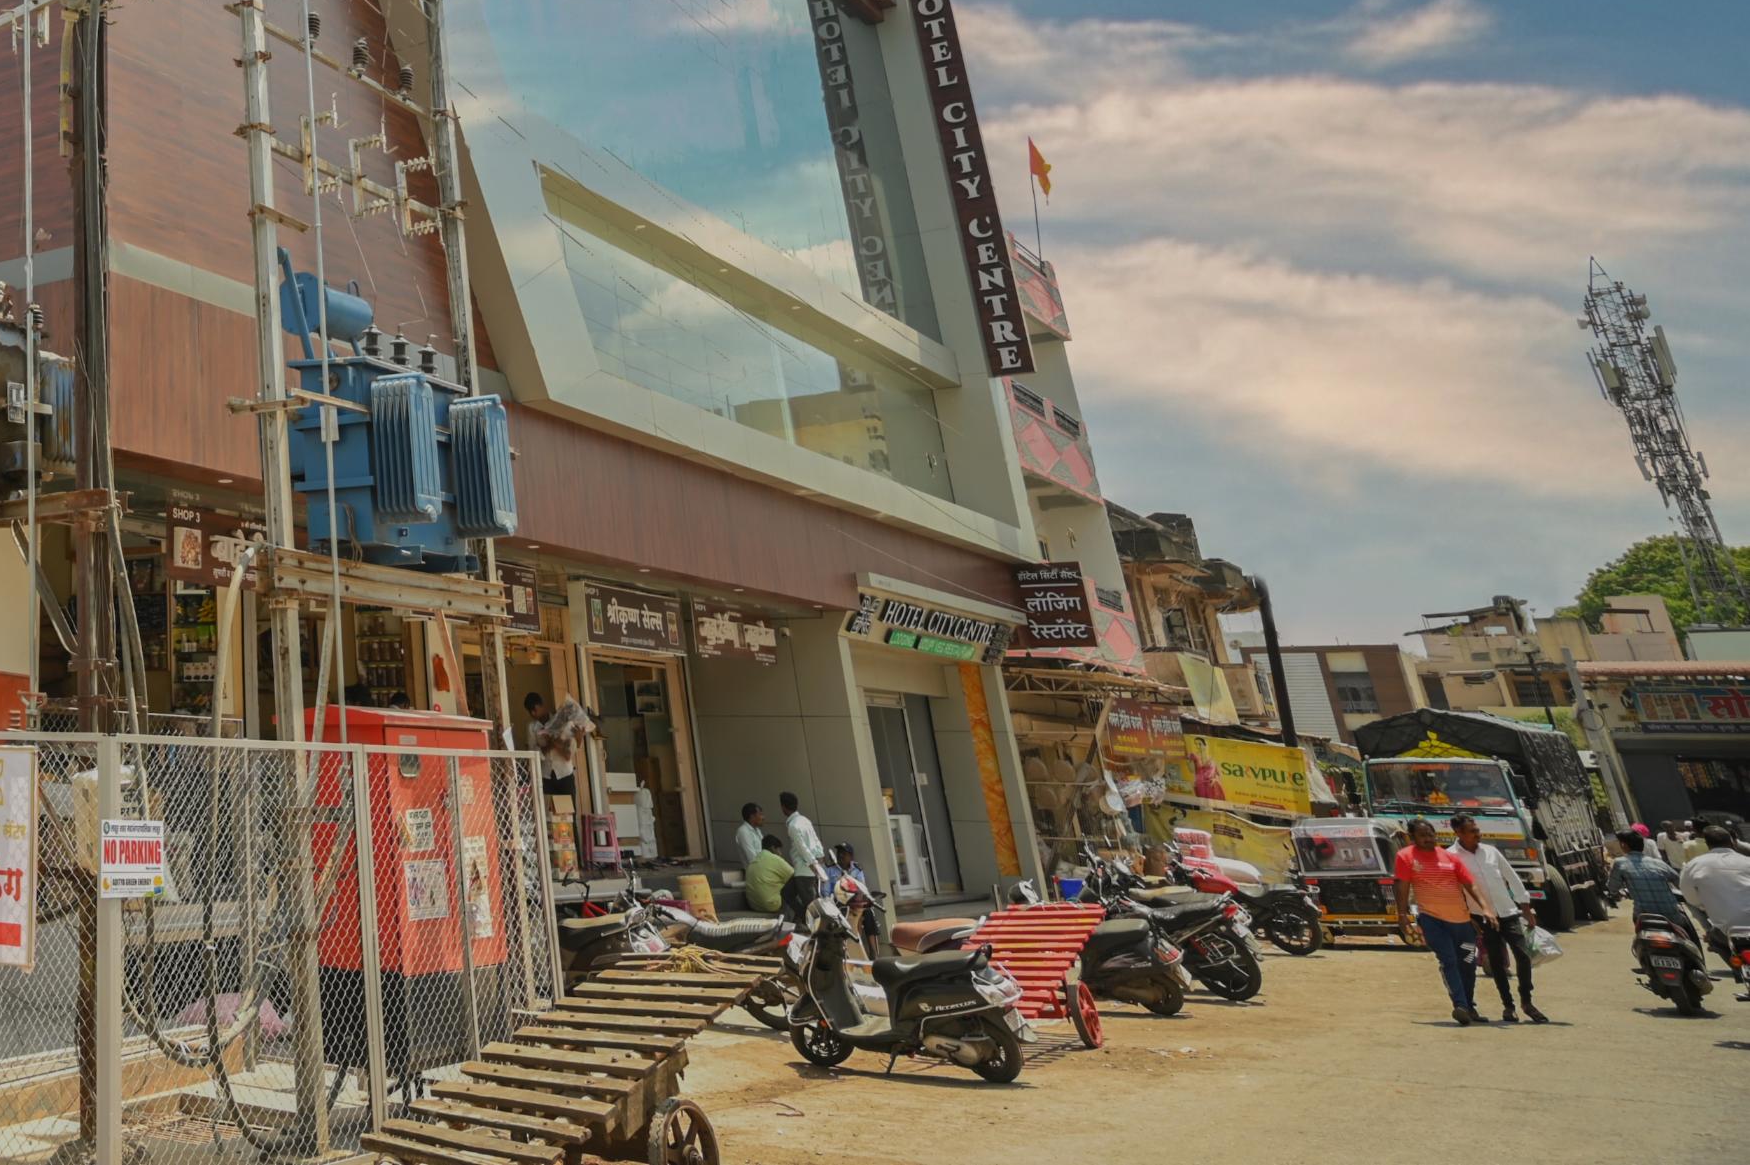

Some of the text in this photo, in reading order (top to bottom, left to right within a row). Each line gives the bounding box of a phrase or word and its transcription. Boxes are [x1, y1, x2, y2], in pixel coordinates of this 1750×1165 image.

[942, 102, 982, 200] CITY
[968, 217, 1023, 372] CENTRE
[172, 507, 201, 524] SHOP 3
[1025, 591, 1082, 612] लॉजिंग
[607, 597, 641, 635] श्रीकृष्ण
[882, 600, 996, 645] HOTEL CITY CENTRE
[1028, 618, 1089, 640] रेस्टॉरंट
[104, 839, 162, 865] NO PARKING
